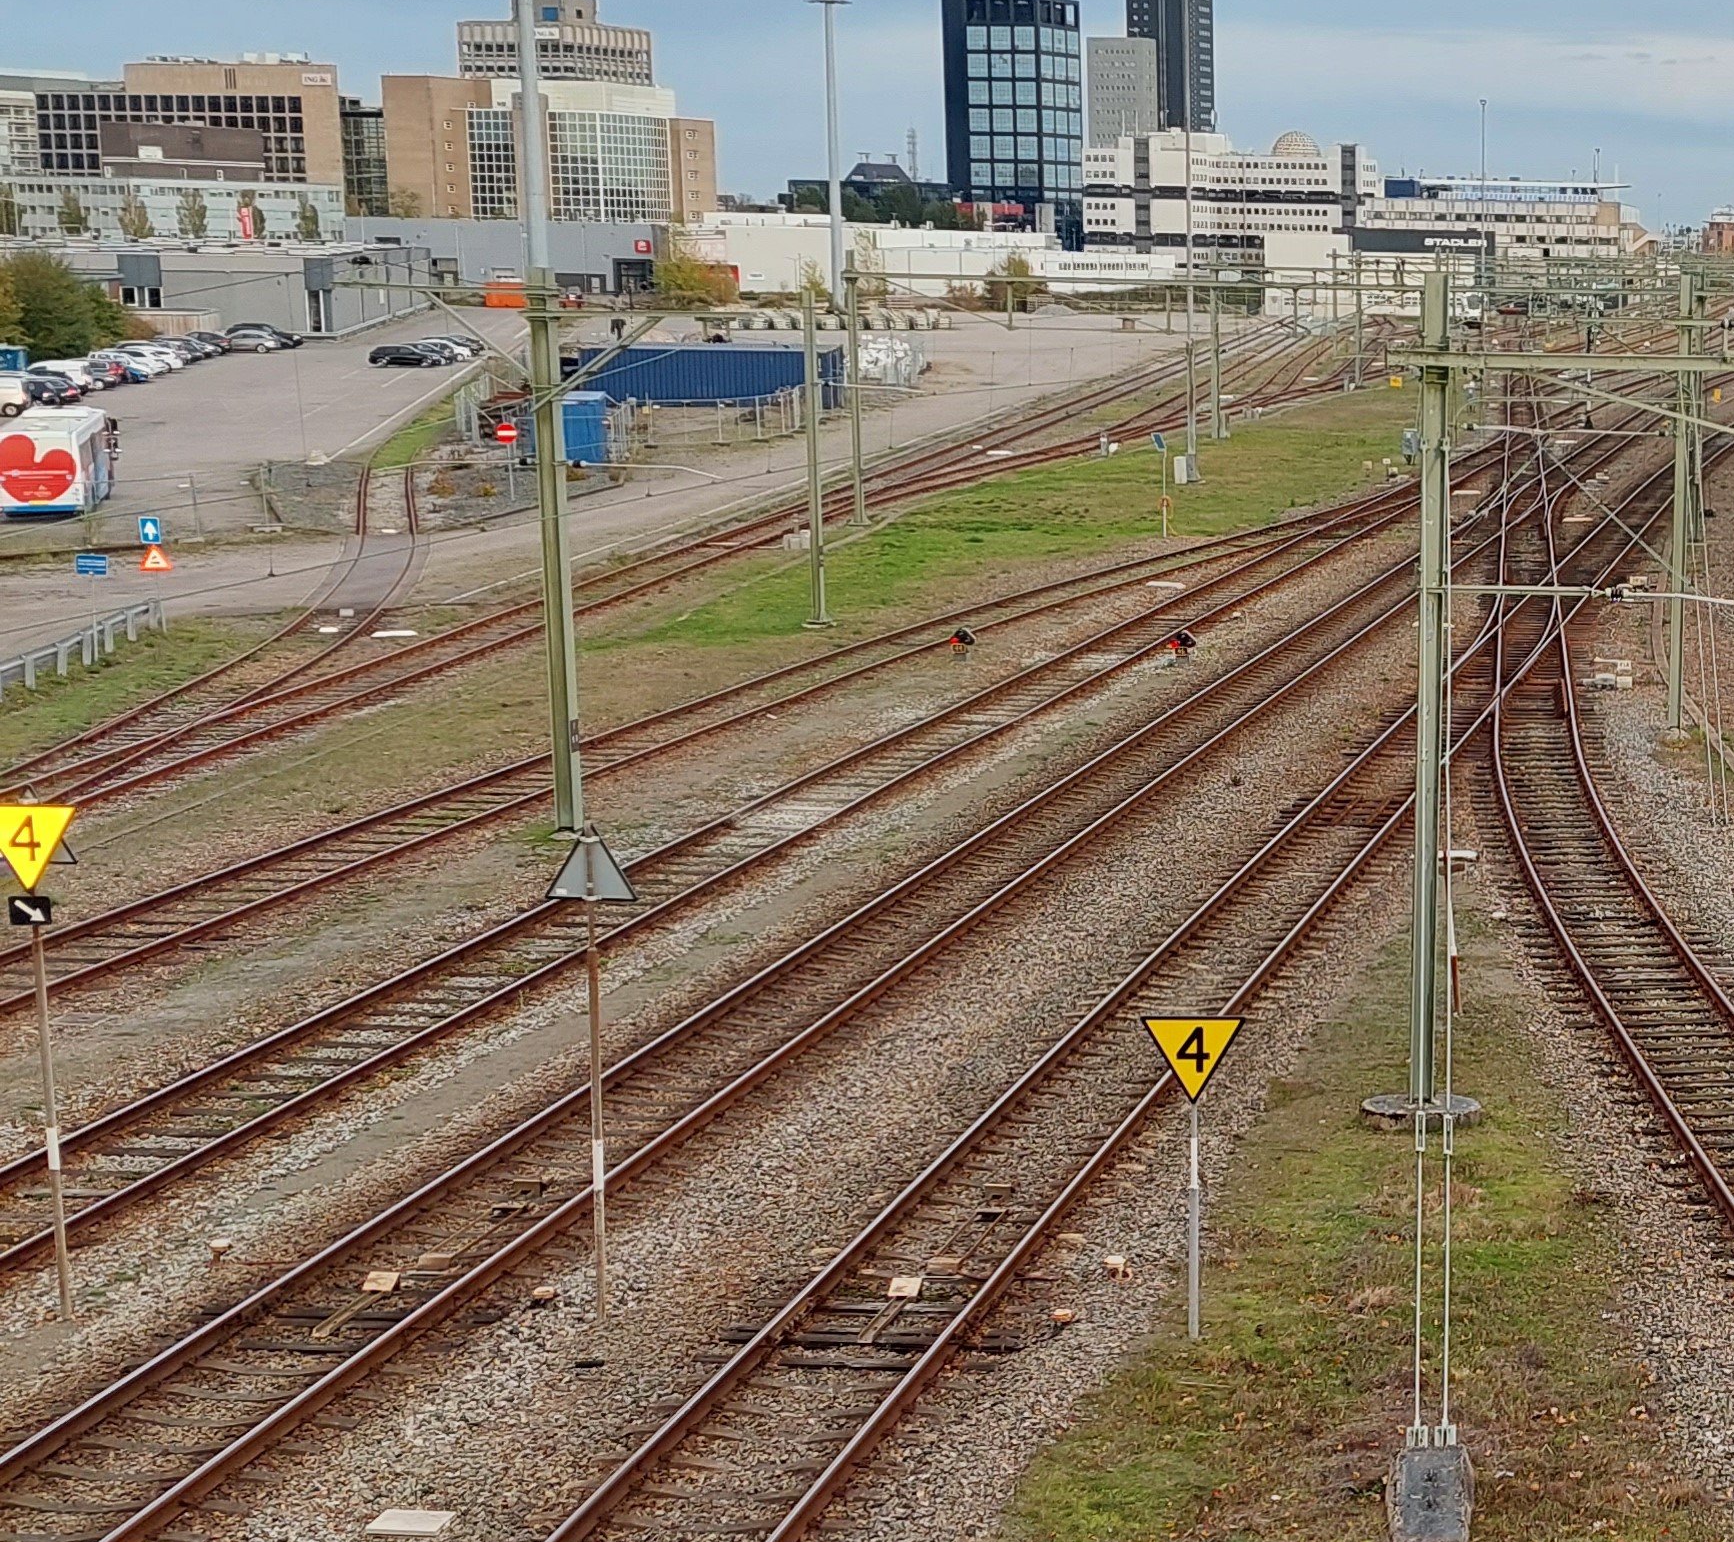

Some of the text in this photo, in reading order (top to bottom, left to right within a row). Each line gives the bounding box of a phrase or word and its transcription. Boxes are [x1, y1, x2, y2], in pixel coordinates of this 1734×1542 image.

[1424, 238, 1488, 247] STADLER
[9, 814, 41, 862] 4
[1176, 1026, 1210, 1074] 4
